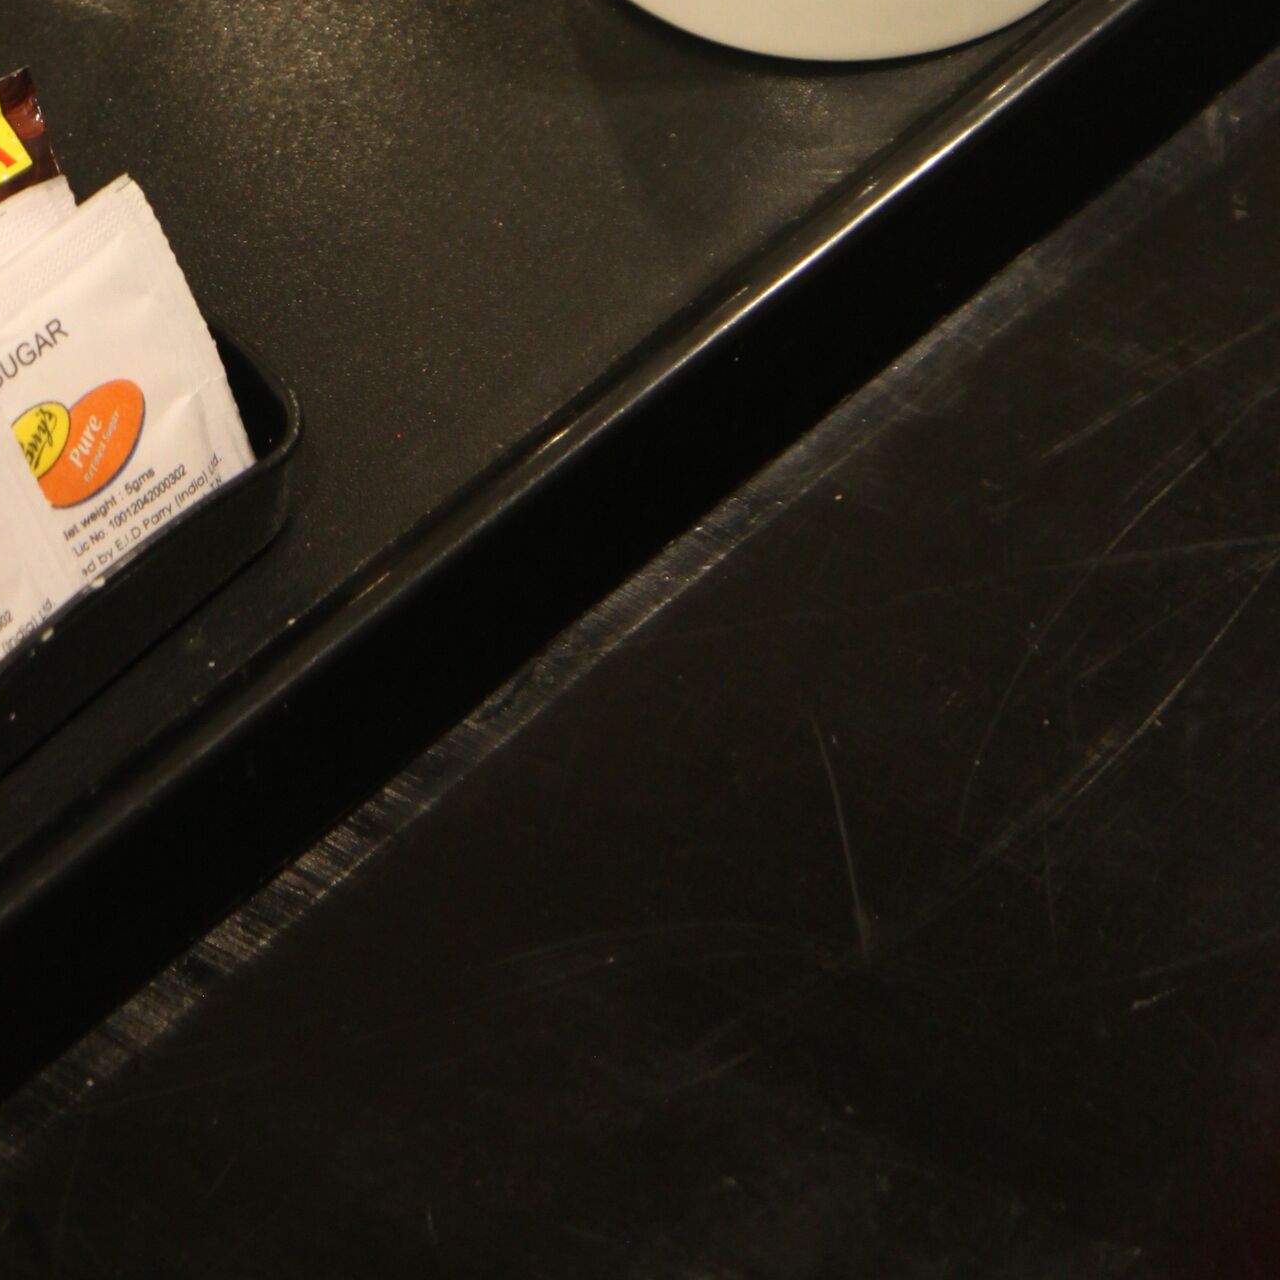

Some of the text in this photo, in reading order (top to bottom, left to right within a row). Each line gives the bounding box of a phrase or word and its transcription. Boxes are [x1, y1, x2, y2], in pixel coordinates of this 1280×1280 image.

[69, 414, 103, 469] Pure
[72, 540, 91, 558] Lic
[107, 463, 188, 529] 10012042000302
[79, 494, 118, 528] weight
[123, 466, 156, 496] 5gms
[98, 547, 115, 567] by
